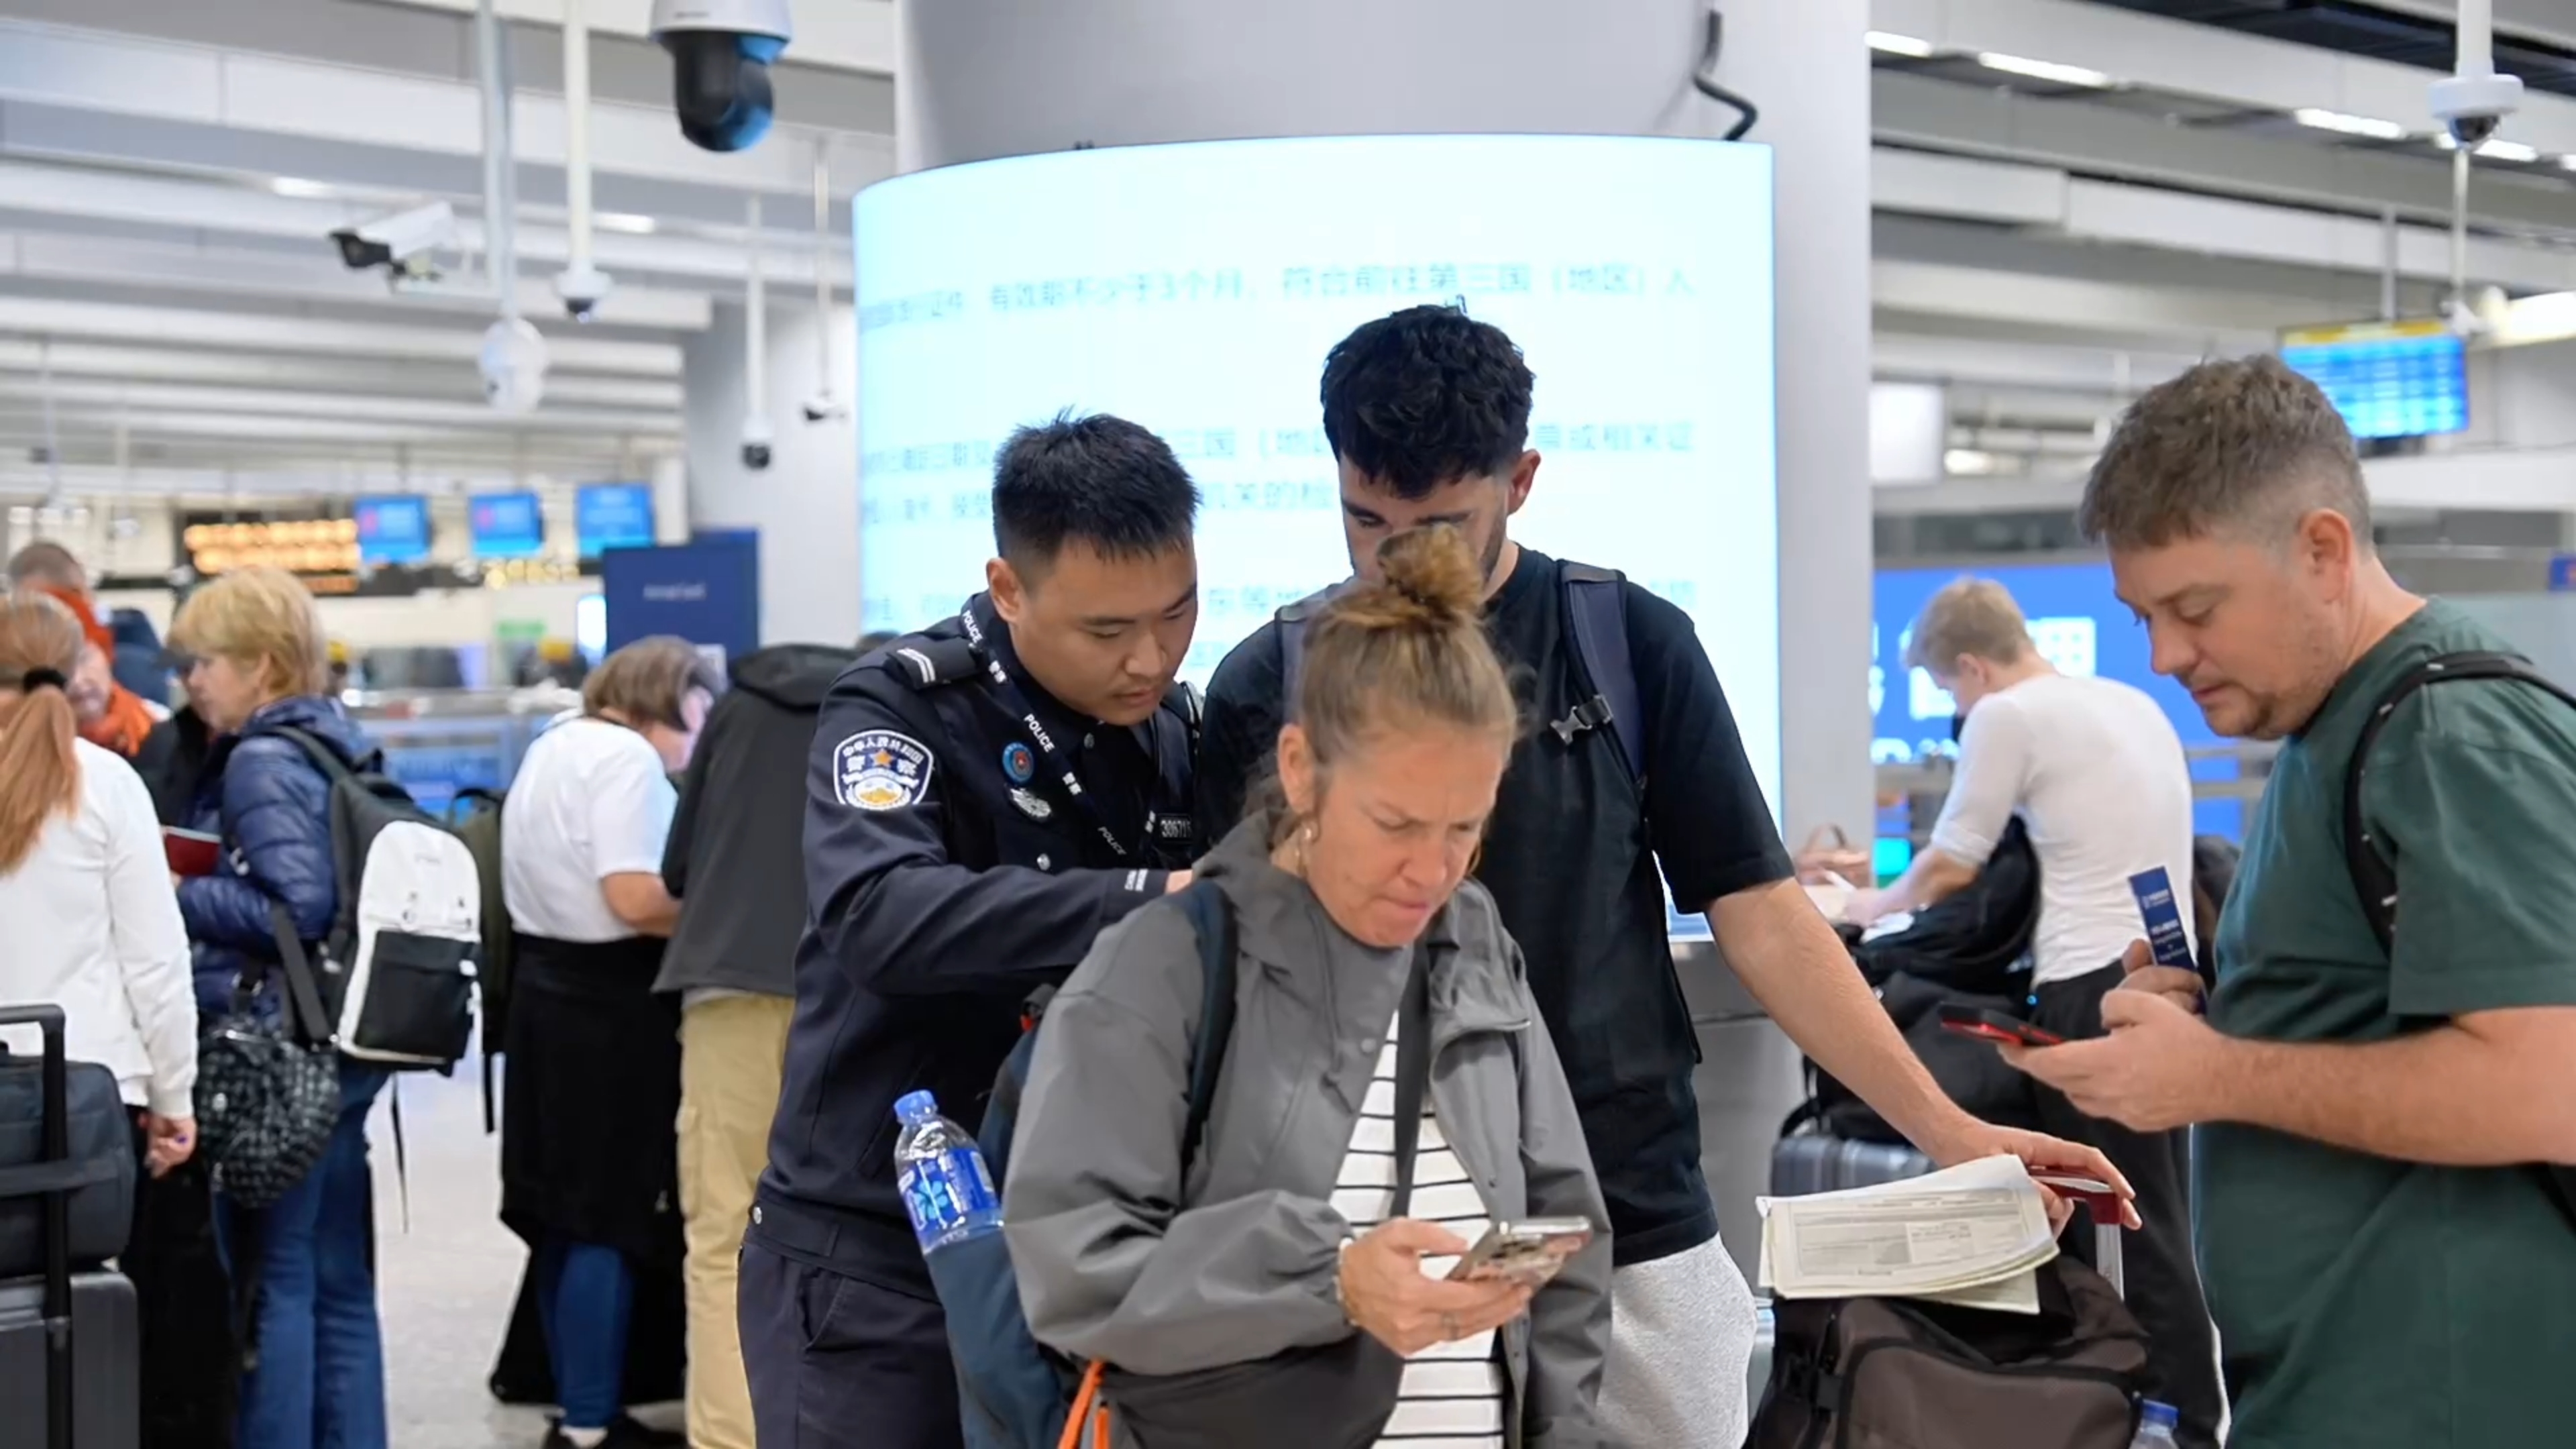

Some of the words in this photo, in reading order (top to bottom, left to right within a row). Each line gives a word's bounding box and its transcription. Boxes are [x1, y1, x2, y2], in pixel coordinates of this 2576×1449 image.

[963, 610, 983, 643] POLICE
[1024, 713, 1055, 753] POLICE
[1097, 826, 1128, 855] POLICE
